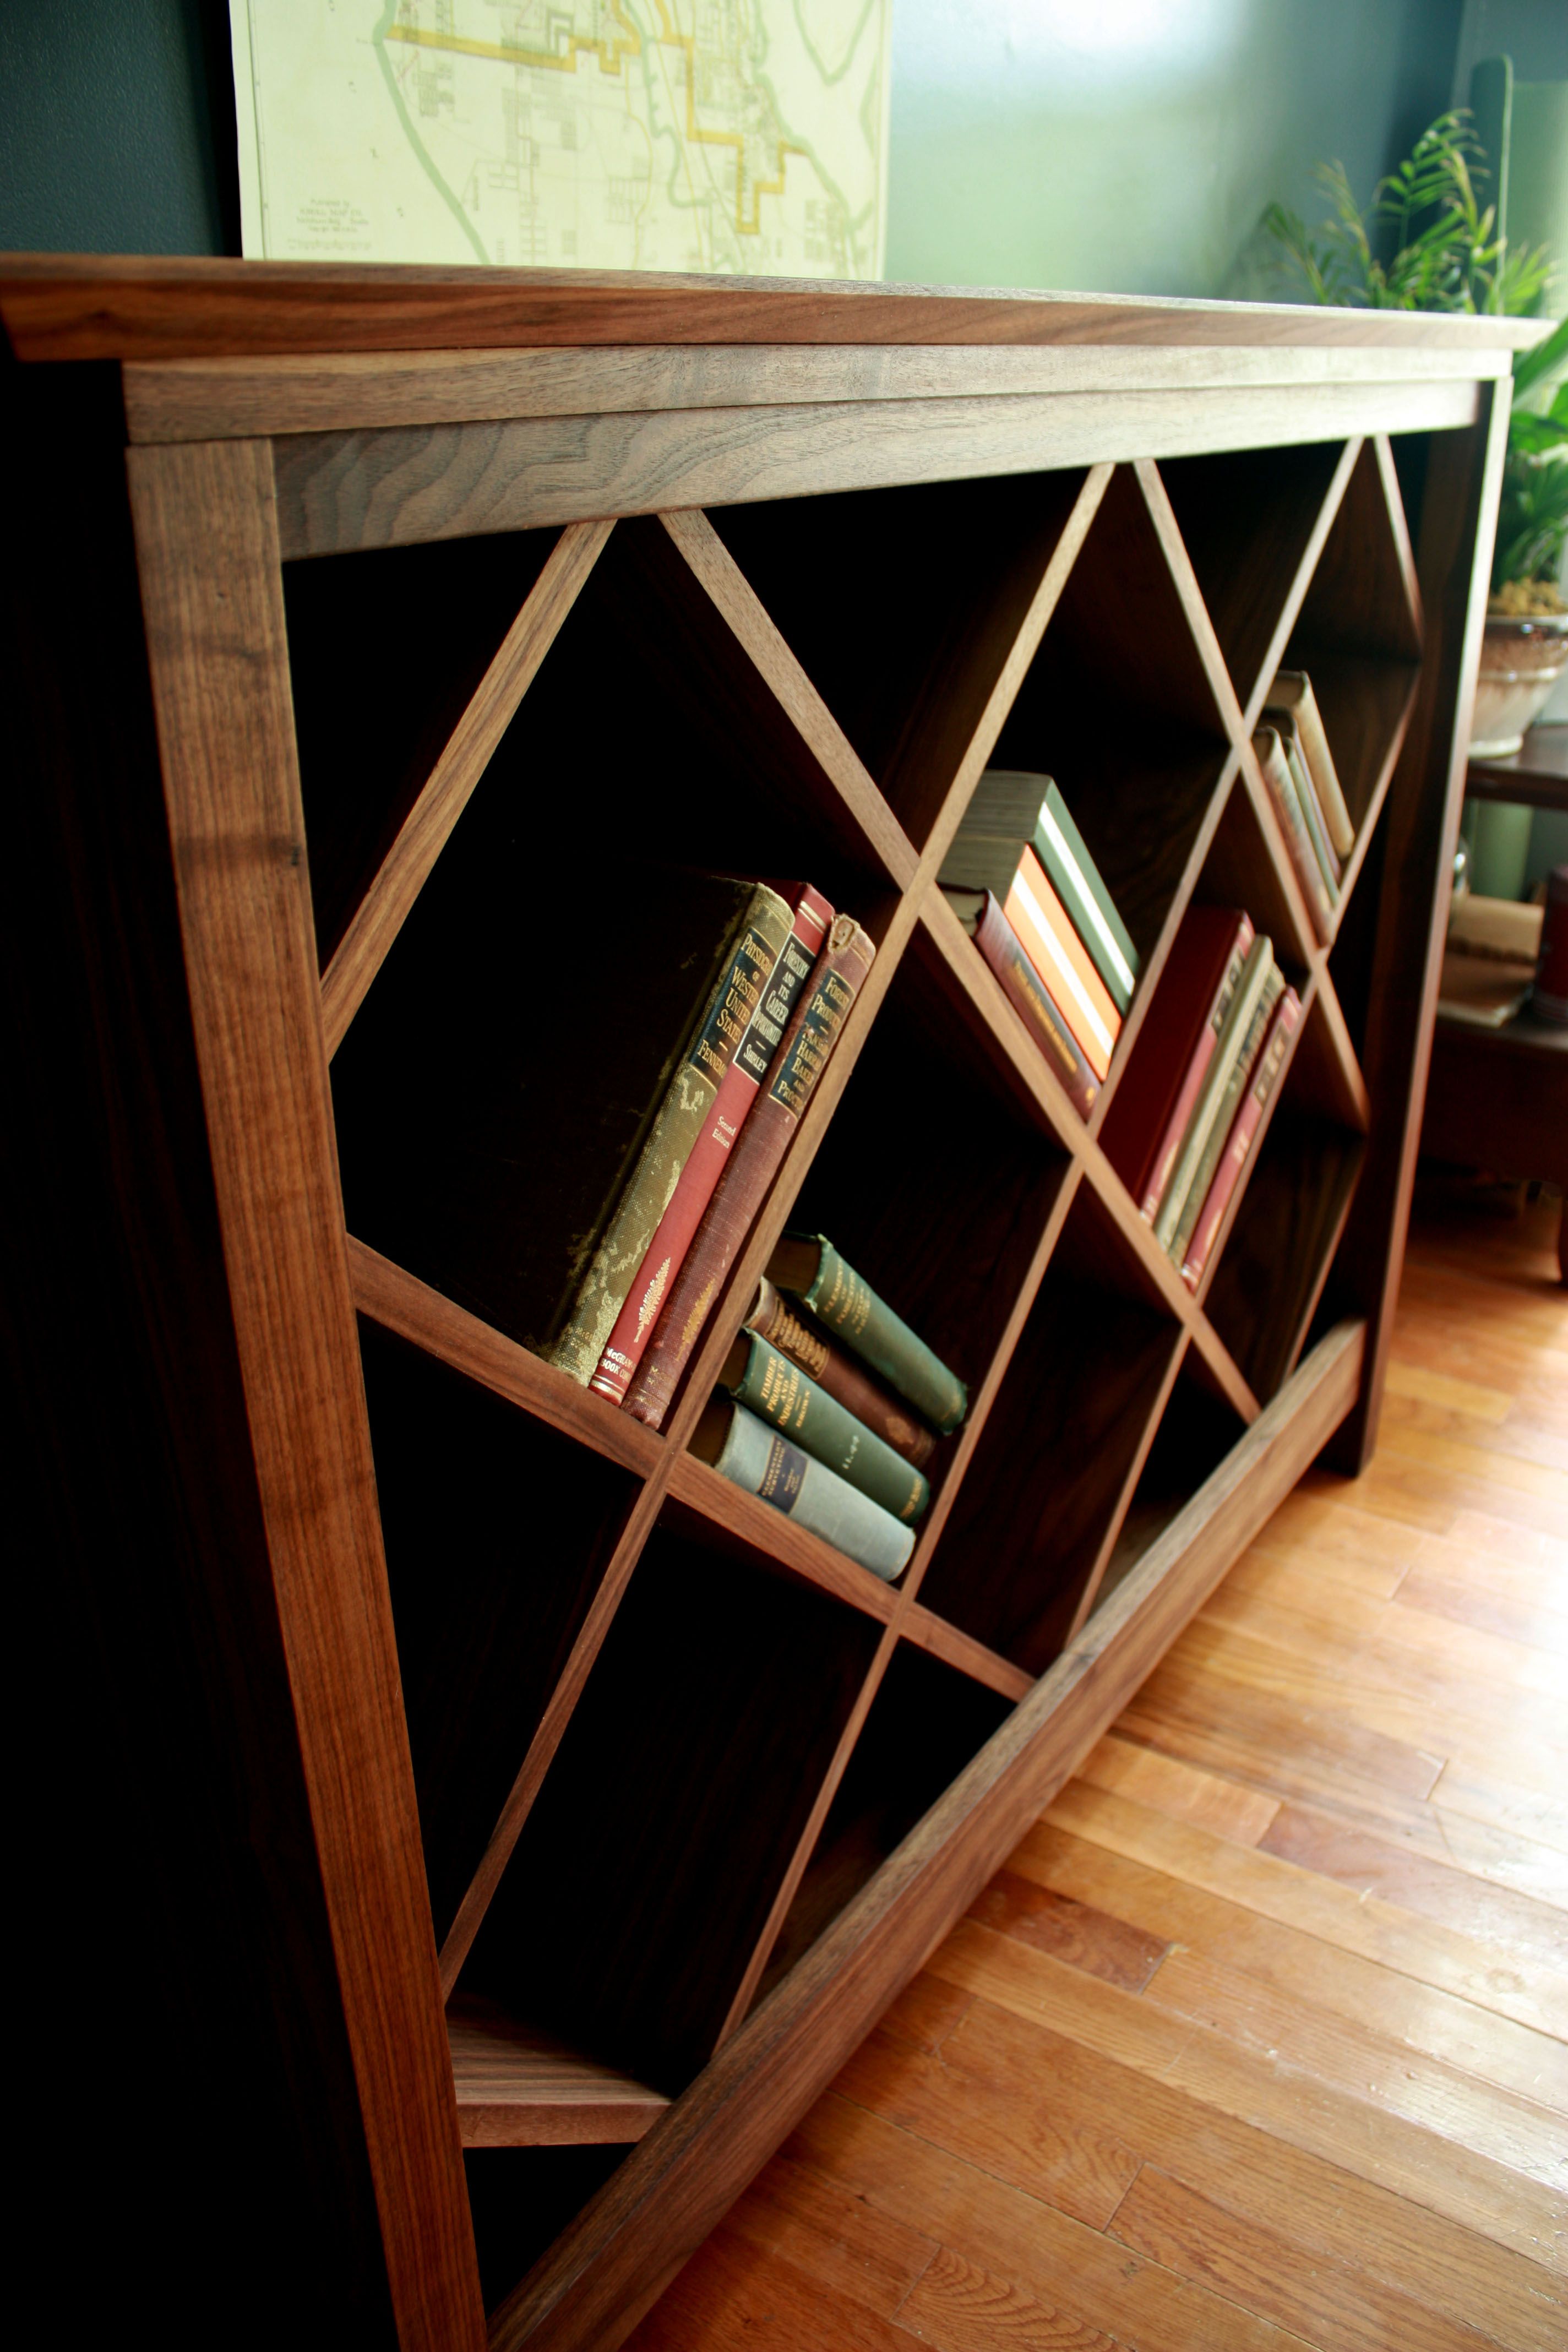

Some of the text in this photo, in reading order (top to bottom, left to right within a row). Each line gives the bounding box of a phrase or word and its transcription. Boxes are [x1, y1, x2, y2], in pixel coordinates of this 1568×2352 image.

[783, 942, 810, 979] FORESTRY
[778, 984, 790, 1000] ITS
[782, 971, 796, 988] AND
[766, 990, 788, 1025] CAREER
[717, 1009, 743, 1044] STATES
[743, 1044, 767, 1073] SHIRLEY
[712, 1128, 730, 1149] Edition
[717, 1115, 736, 1137] Second
[600, 1358, 620, 1375] BOOK
[761, 1356, 777, 1398] TIMBER
[766, 1358, 785, 1412] PRODUCTS
[777, 1367, 800, 1427] INDUSTRIES
[780, 1379, 790, 1402] AND
[796, 1389, 810, 1428] BROWN
